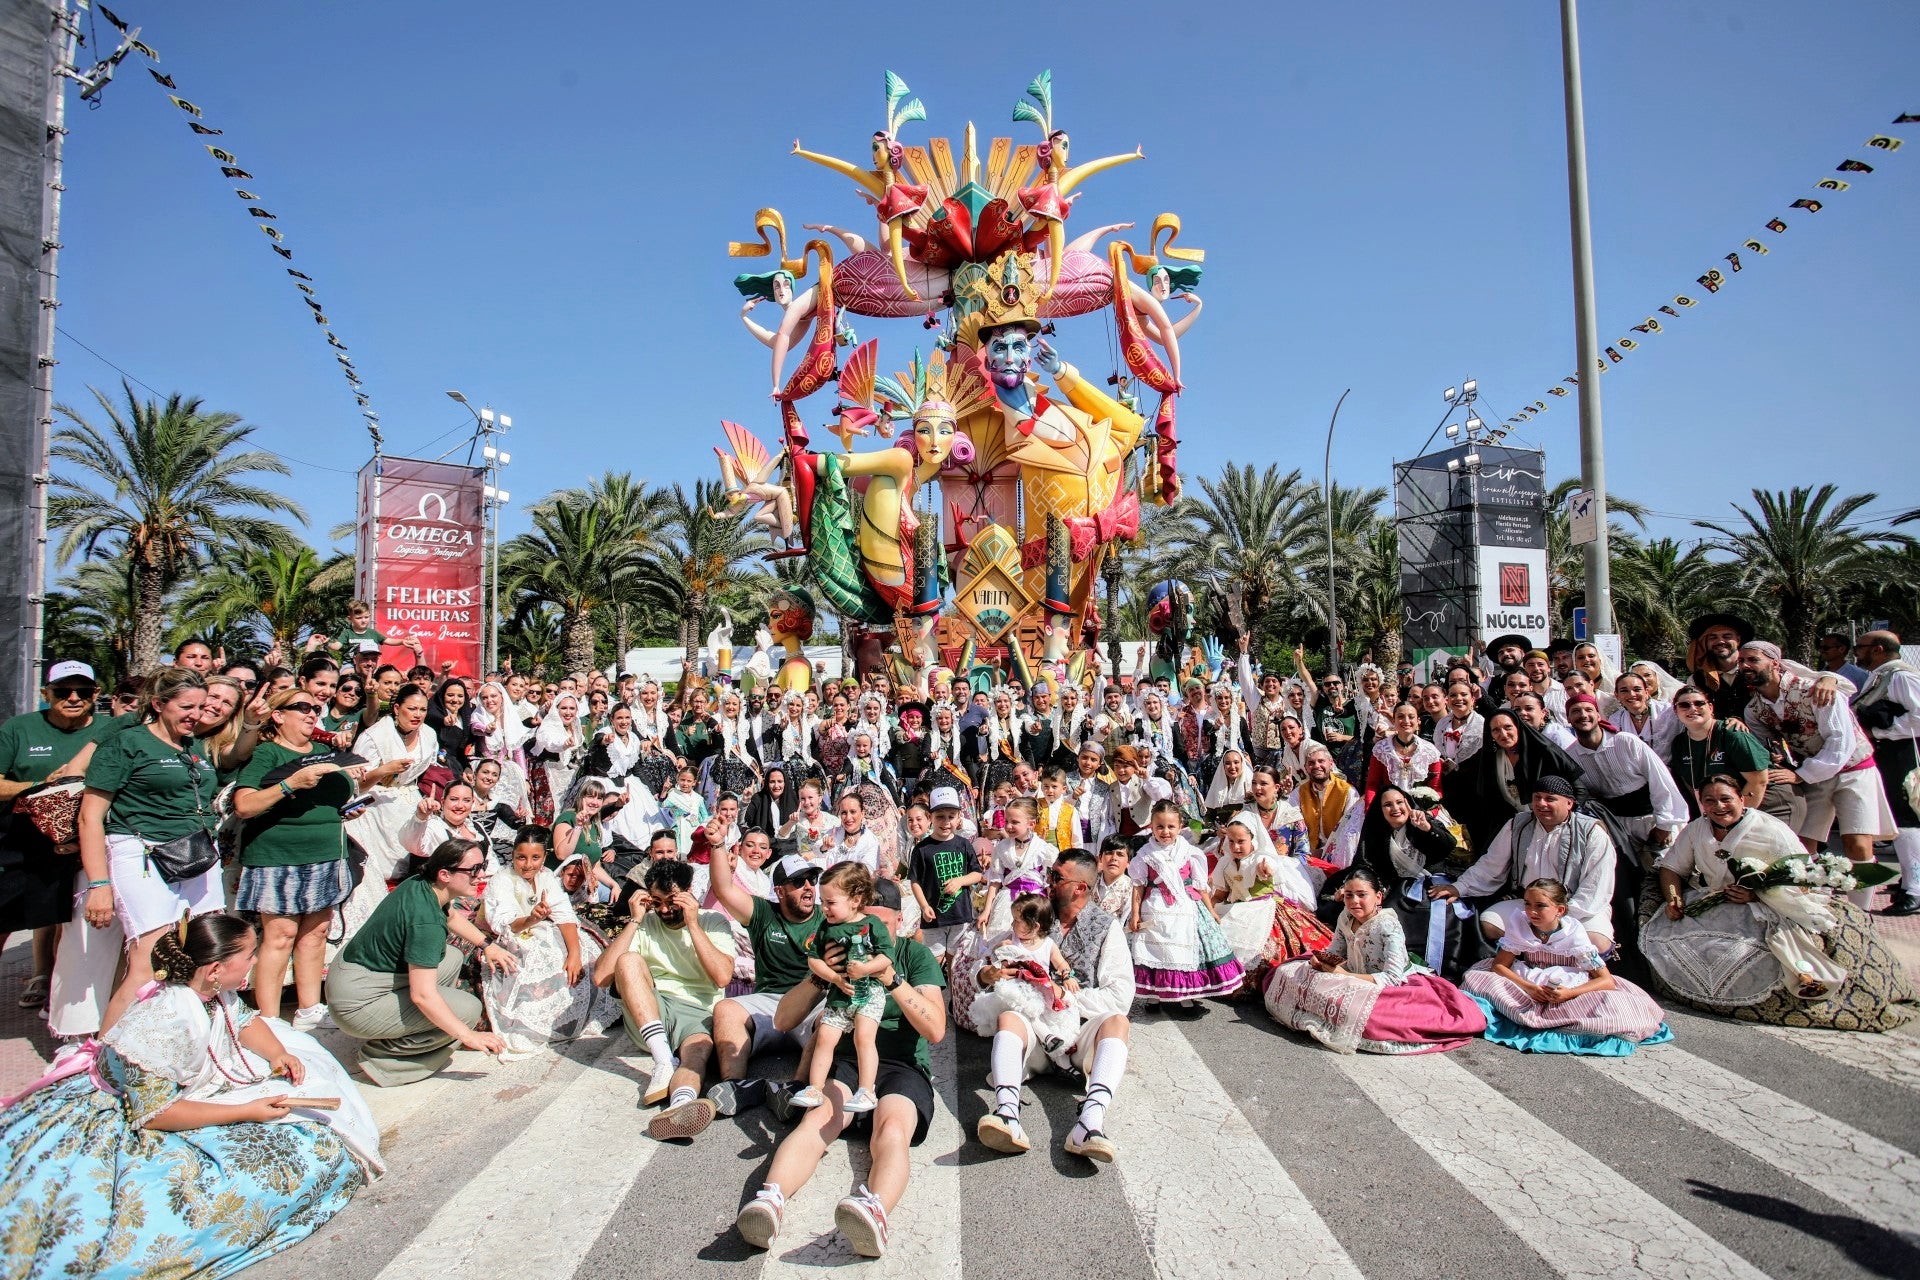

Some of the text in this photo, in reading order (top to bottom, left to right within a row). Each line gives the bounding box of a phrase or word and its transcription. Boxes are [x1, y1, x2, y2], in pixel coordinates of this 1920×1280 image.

[1491, 497, 1534, 506] ESTILISTAS
[387, 524, 474, 546] OMEGA
[433, 547, 468, 560] Integral
[386, 586, 471, 606] FELICES
[973, 590, 1012, 605] VANITY
[387, 607, 470, 622] HOGUERAS
[1486, 610, 1545, 629] NÚCLEO
[386, 624, 471, 640] de San Juan
